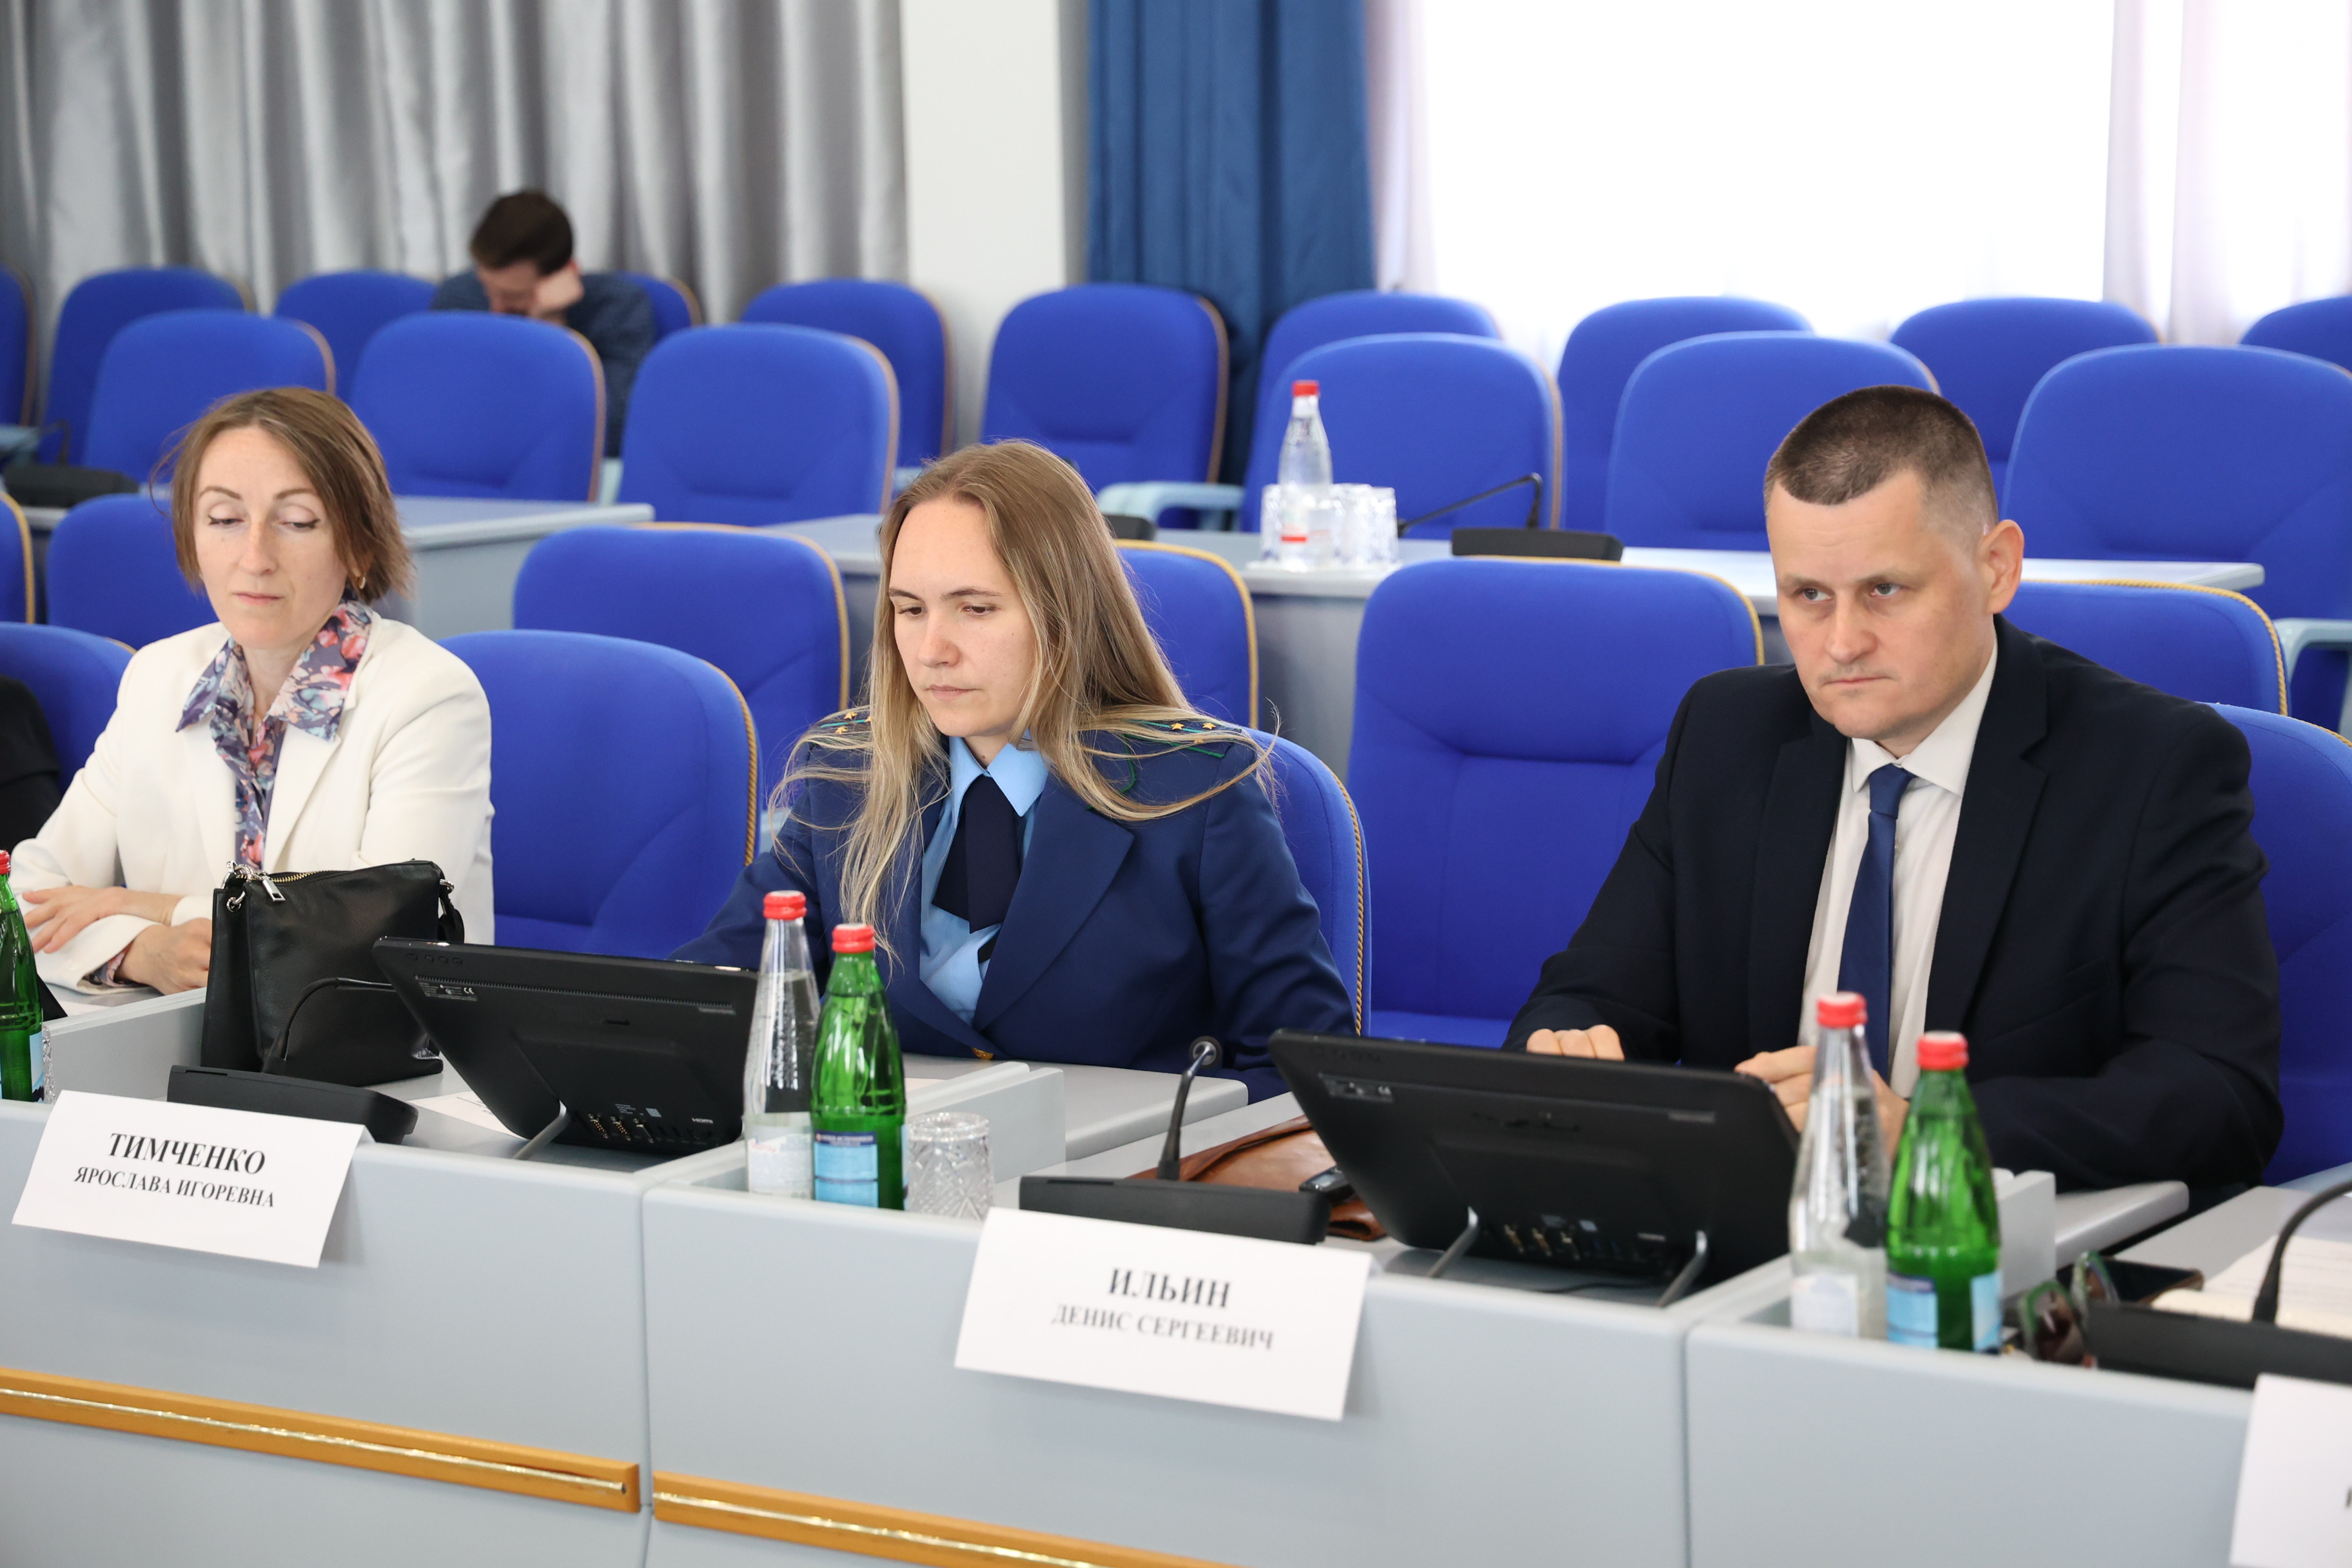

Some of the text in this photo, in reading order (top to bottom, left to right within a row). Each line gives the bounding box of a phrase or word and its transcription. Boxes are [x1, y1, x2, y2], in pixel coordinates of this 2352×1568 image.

[108, 1133, 266, 1174] ТИМЧЕНКО
[74, 1166, 274, 1208] ЯРОСЛАВА ИГОРЕВНА
[1108, 1268, 1232, 1309] ИЛЬИН
[1052, 1304, 1273, 1350] ДЕНИС СЕРГЕЕВИЧ
